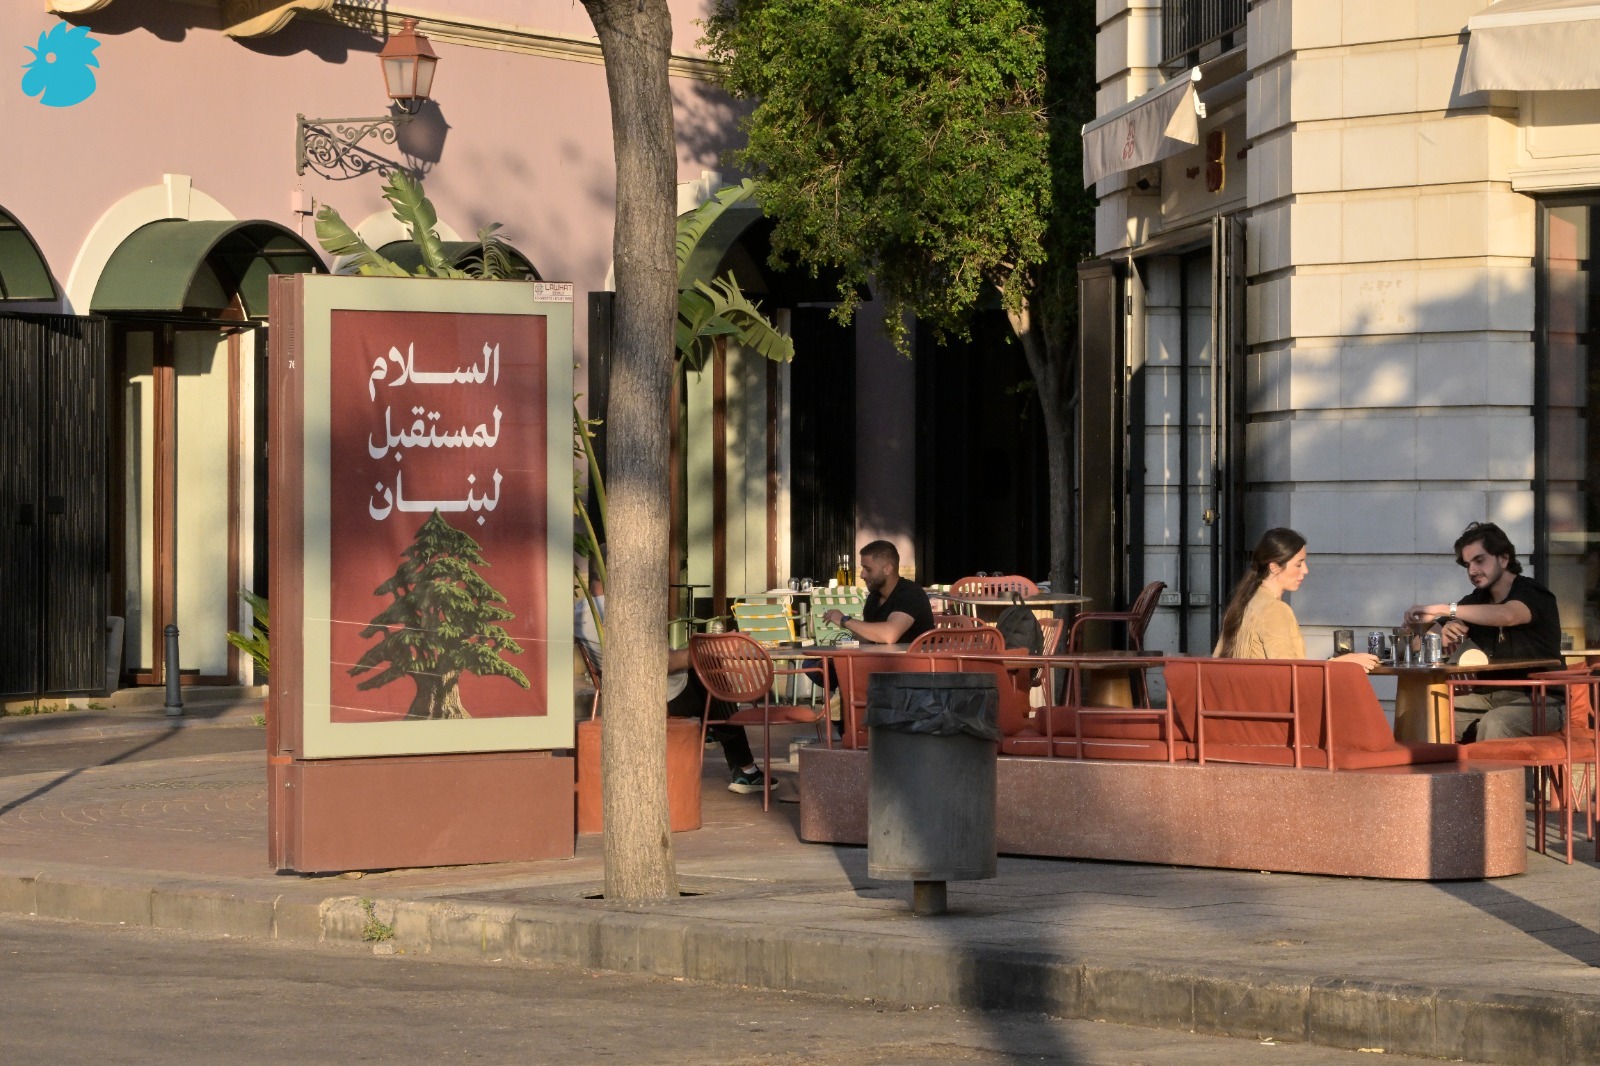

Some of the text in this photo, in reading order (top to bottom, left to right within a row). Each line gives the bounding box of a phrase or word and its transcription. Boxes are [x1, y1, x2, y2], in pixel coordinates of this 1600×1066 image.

[544, 283, 573, 291] LAWHAT
[368, 341, 500, 402] السلام
[368, 404, 503, 462] لمستقبل
[368, 467, 503, 526] لبنان
